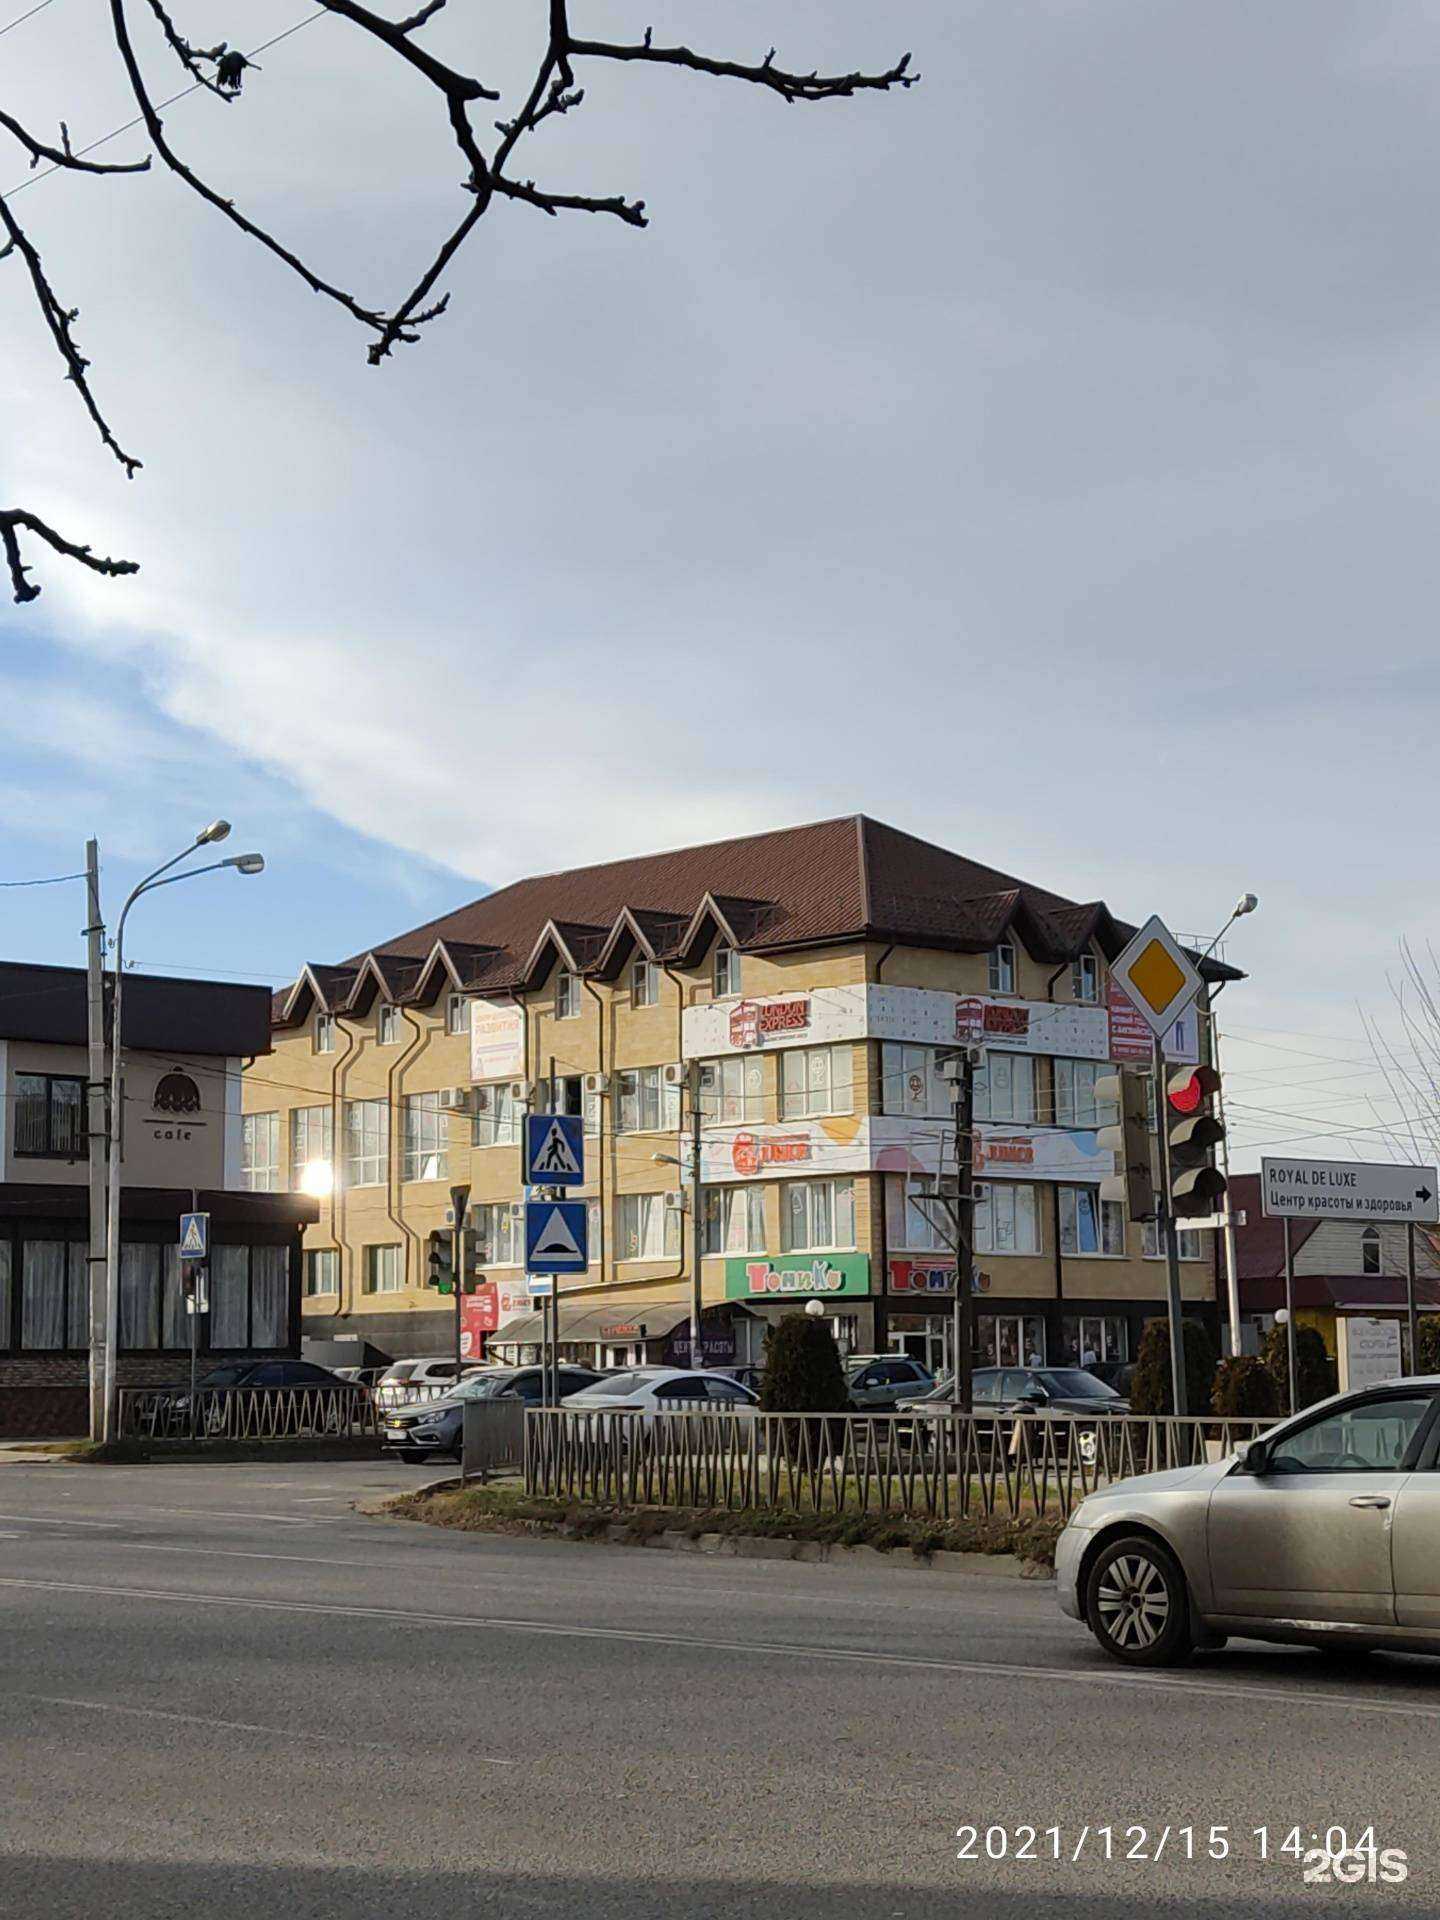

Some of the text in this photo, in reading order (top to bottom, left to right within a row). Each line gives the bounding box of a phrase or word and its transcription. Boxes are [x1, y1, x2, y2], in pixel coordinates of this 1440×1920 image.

[758, 1014, 805, 1031] EXPRESS
[1269, 1168, 1358, 1187] ROYAL DE LUXE
[1270, 1190, 1413, 1213] Центр красоты и здоровья
